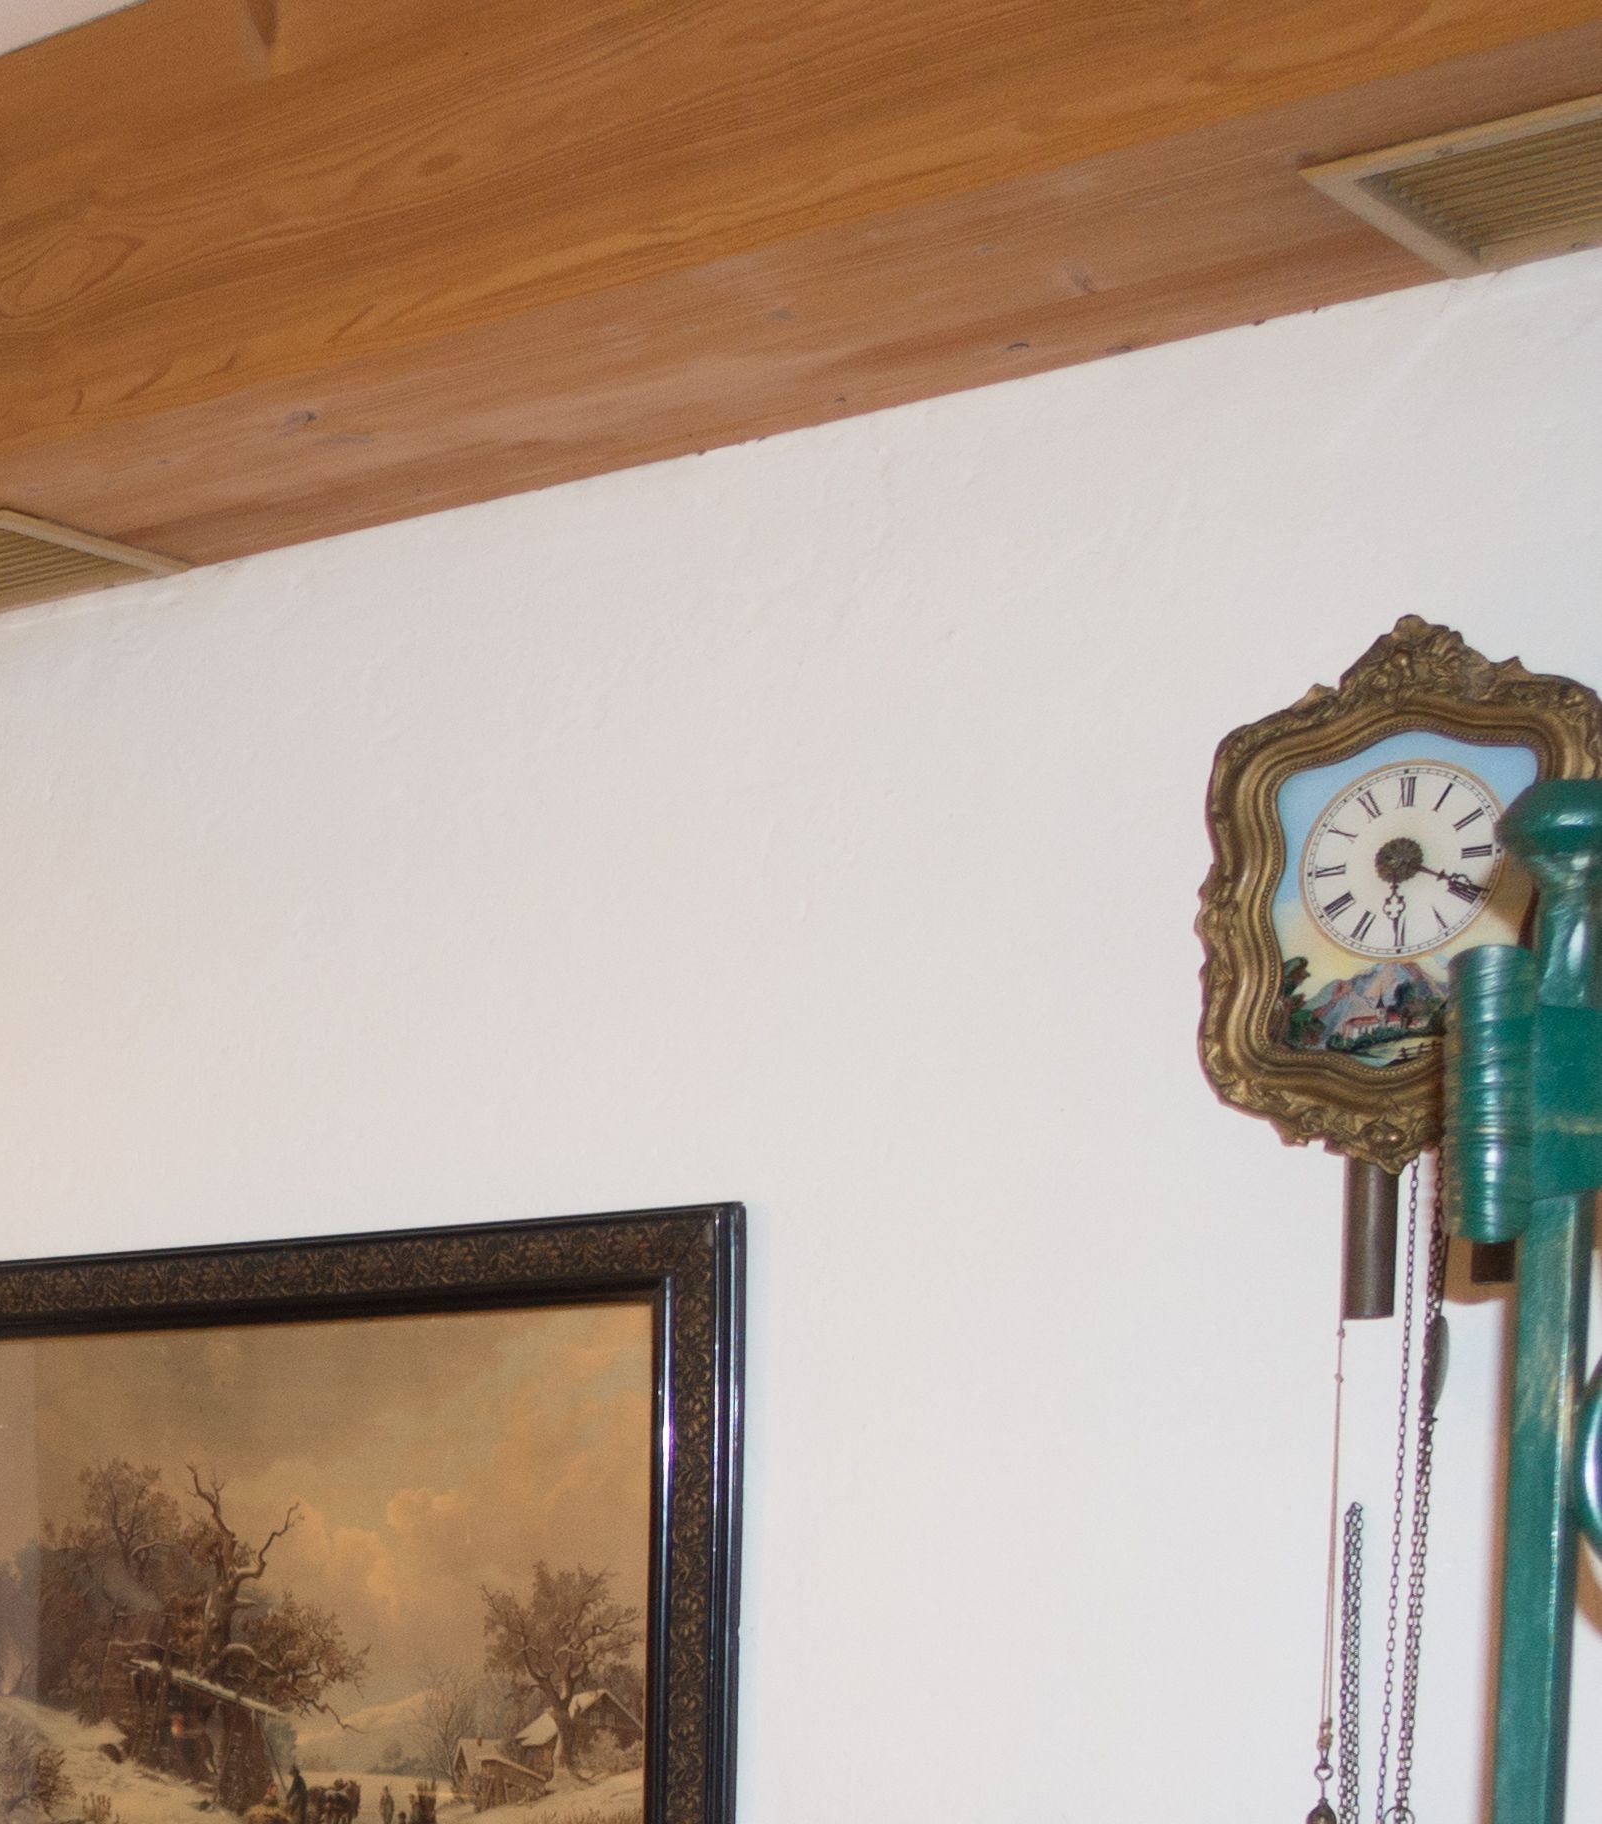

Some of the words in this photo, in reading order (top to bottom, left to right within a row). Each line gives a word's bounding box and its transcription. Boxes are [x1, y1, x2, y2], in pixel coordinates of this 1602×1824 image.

[1396, 776, 1417, 809] XII
[1452, 806, 1485, 832] II
[1461, 844, 1493, 859] III
